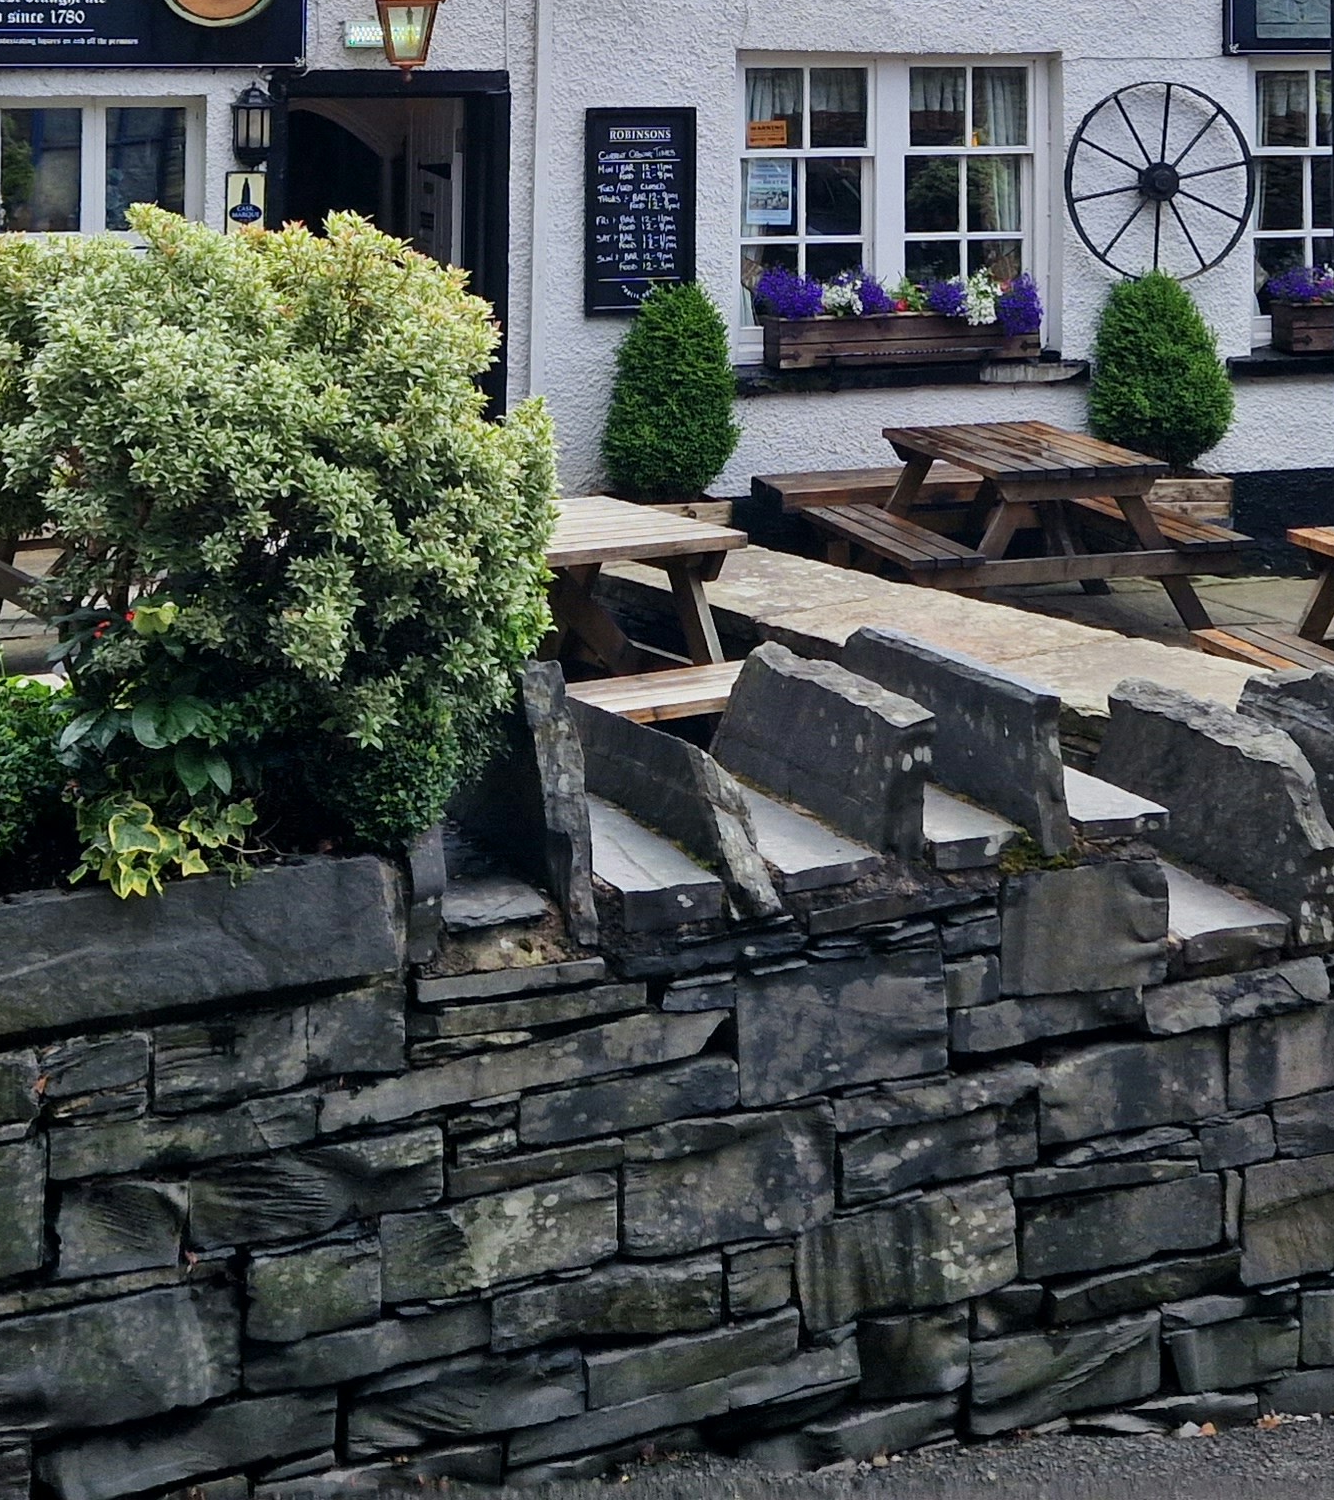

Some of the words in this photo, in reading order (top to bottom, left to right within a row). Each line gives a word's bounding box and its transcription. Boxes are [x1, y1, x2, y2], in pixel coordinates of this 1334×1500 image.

[7, 9, 44, 24] since
[50, 10, 85, 24] 1780
[609, 130, 671, 140] ROBINSONS
[231, 211, 260, 219] MARQUE
